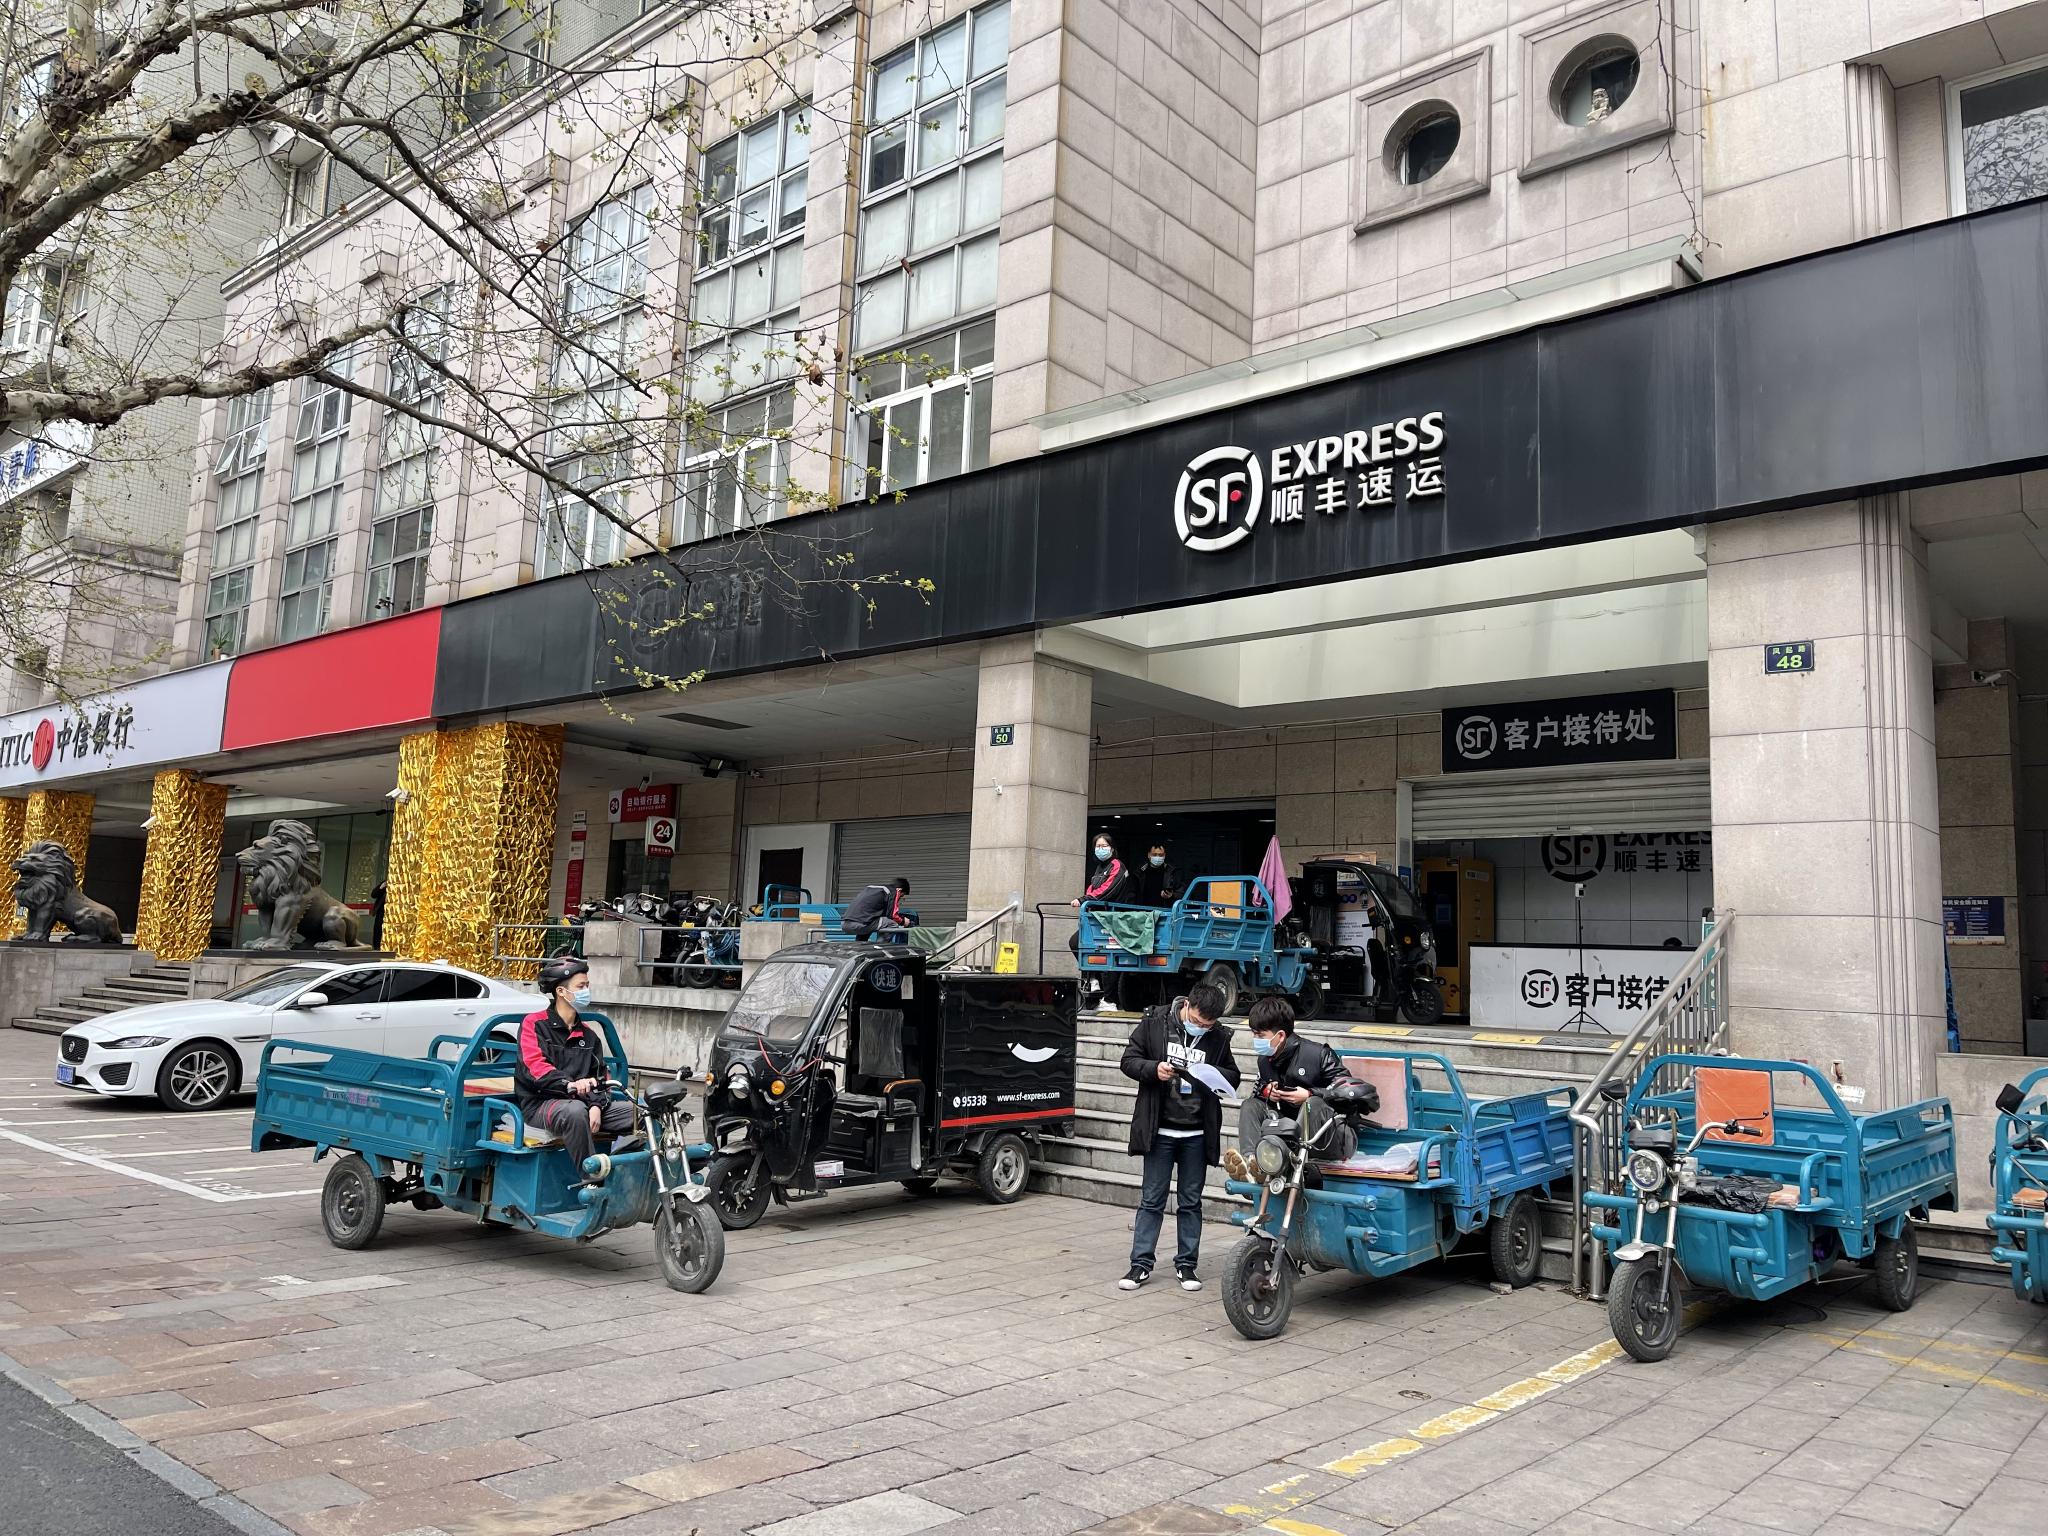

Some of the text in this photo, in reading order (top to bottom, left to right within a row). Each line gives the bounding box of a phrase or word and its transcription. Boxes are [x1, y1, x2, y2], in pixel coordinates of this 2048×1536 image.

[1271, 411, 1445, 484] EXPRESS
[1189, 471, 1247, 528] SF
[1270, 456, 1445, 526] 顺丰速运
[1776, 654, 1803, 669] 48
[57, 706, 134, 763] 中信银行
[995, 734, 1008, 743] 50
[1463, 727, 1489, 749] SF
[1503, 708, 1655, 750] 客户接待处
[610, 799, 619, 810] 24
[655, 824, 671, 838] 24
[1554, 835, 1594, 866] SF
[1613, 849, 1713, 873] 顺丰速
[874, 967, 897, 988] 快递
[1528, 979, 1552, 999] SF
[961, 1091, 1061, 1107] 95338 www.sf-express.com
